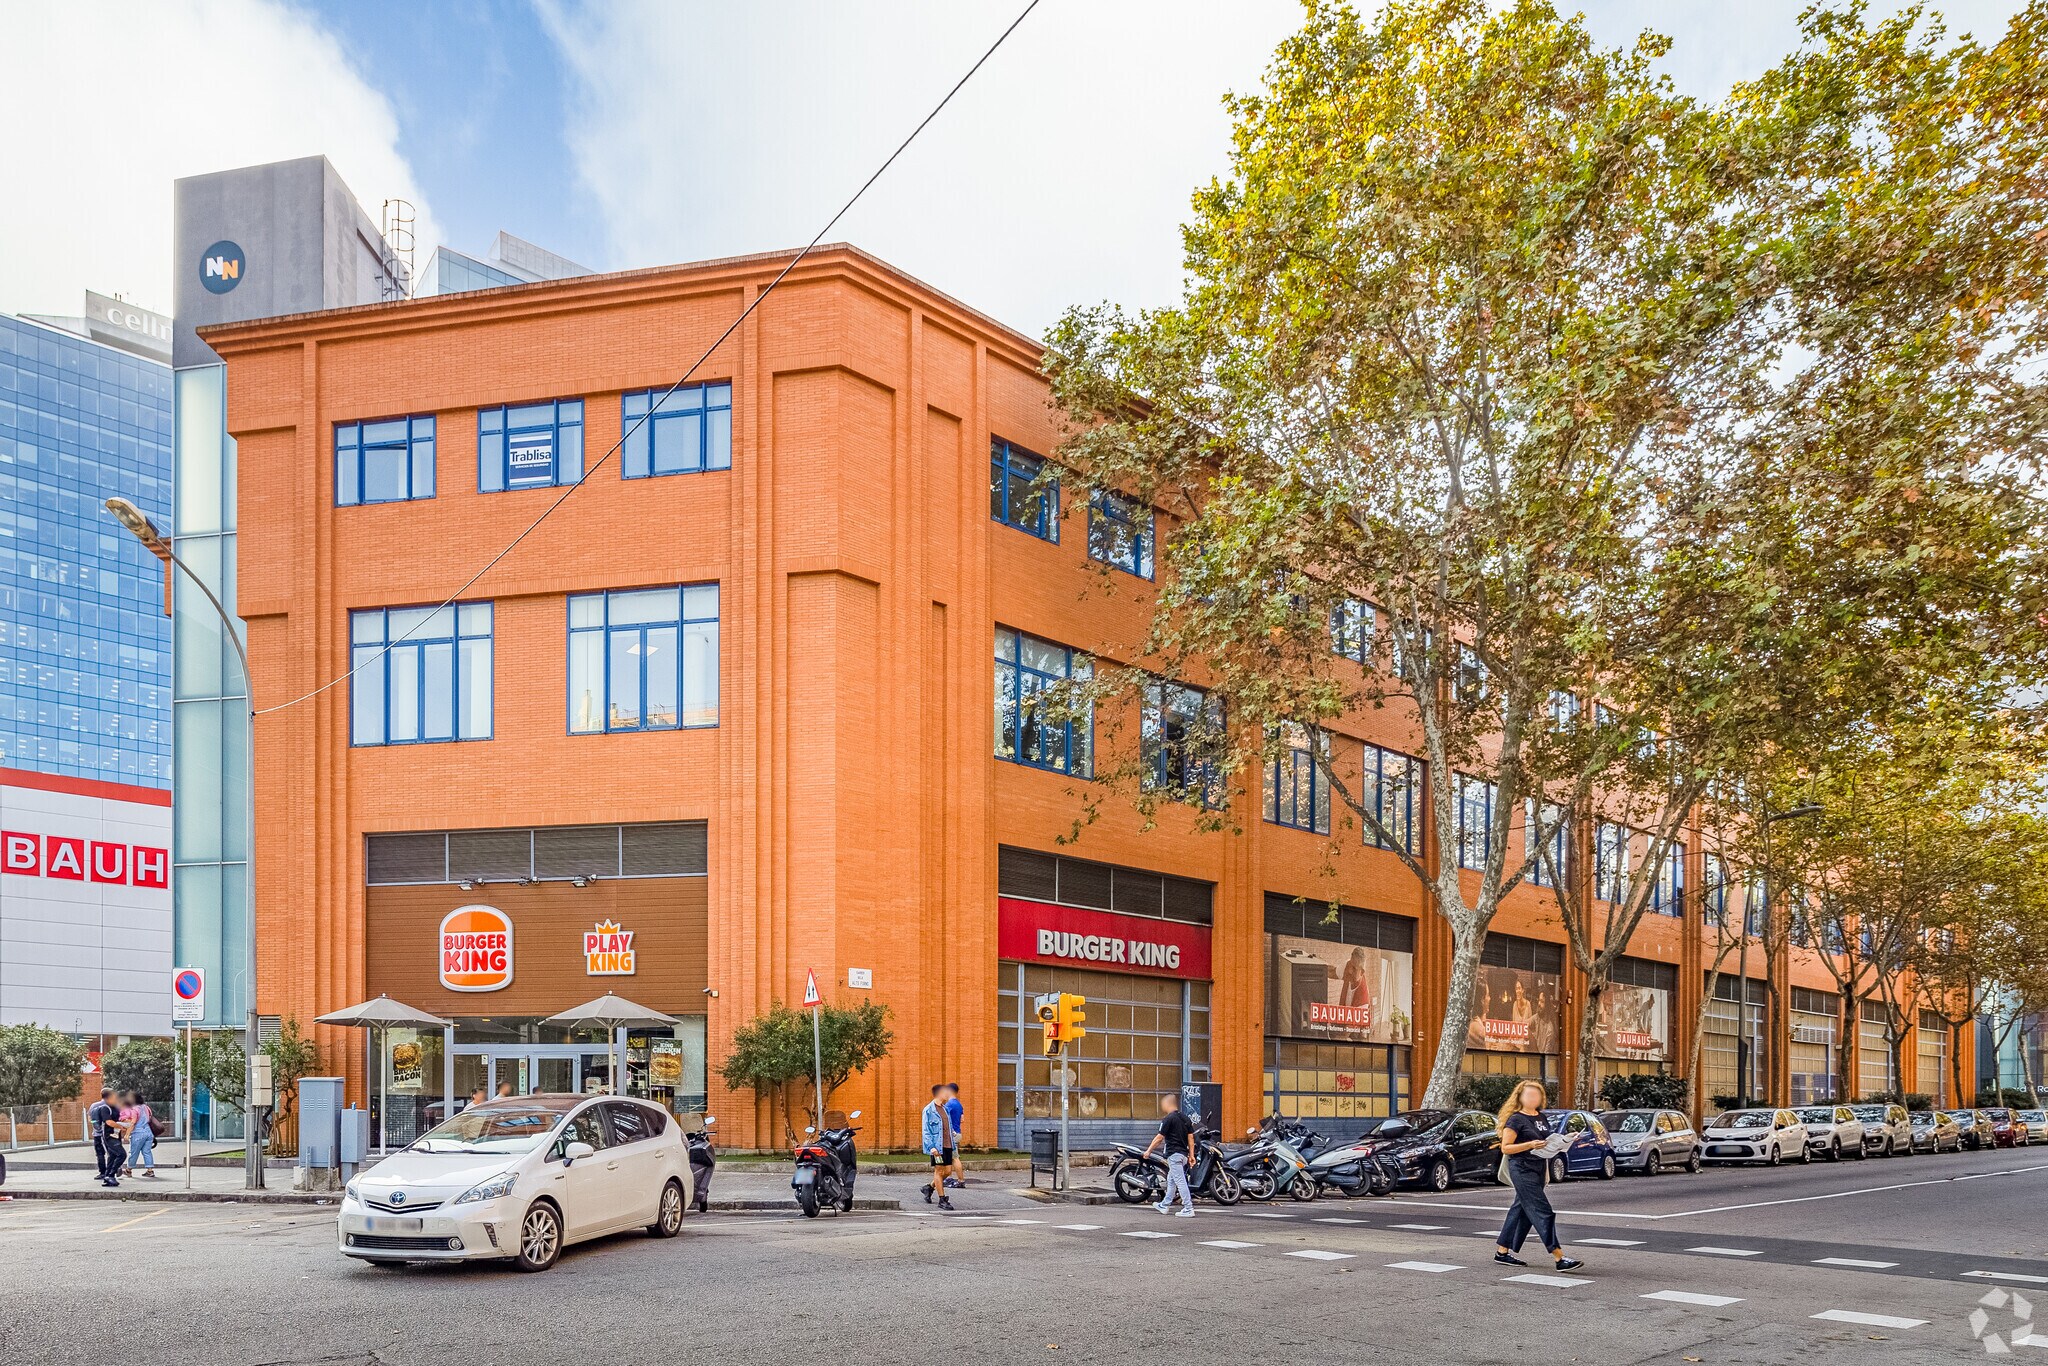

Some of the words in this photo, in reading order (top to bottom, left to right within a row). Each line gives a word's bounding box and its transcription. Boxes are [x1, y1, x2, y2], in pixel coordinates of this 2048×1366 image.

[206, 256, 239, 280] NN
[510, 449, 552, 462] Trablisa
[7, 836, 164, 883] BAUH
[444, 934, 507, 950] BURGER
[586, 934, 630, 953] PLAY
[1037, 929, 1126, 963] BURGER
[1128, 940, 1180, 969] KING
[444, 950, 507, 972] KING
[590, 952, 632, 972] KING
[1312, 1005, 1369, 1024] BAUHAUS
[1485, 1021, 1529, 1036] BAUHAUS
[1616, 1033, 1651, 1047] BAUHAUS
[393, 1071, 421, 1083] BACON
